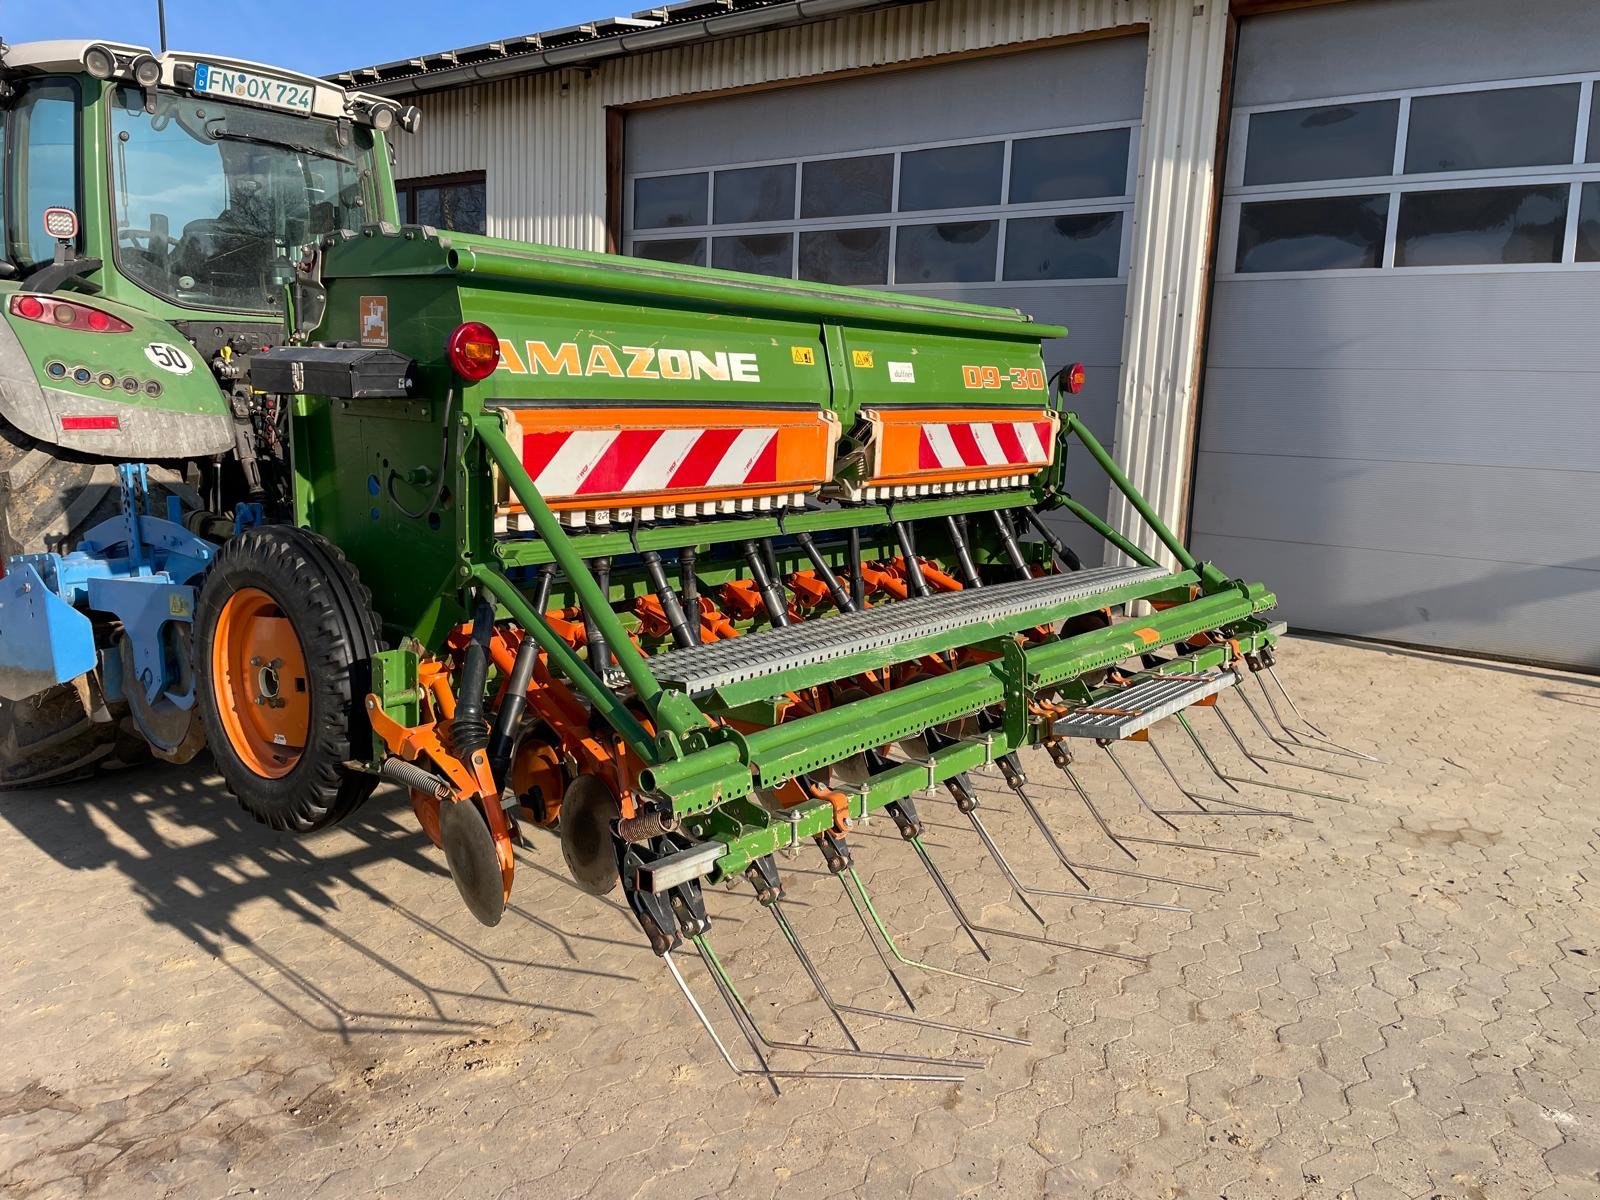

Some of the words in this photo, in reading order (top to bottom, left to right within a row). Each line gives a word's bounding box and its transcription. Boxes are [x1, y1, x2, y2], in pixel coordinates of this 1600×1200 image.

[208, 70, 235, 94] FN
[247, 78, 272, 101] OX
[276, 83, 309, 108] 724
[150, 345, 187, 369] 50
[497, 339, 760, 382] AMAZONE
